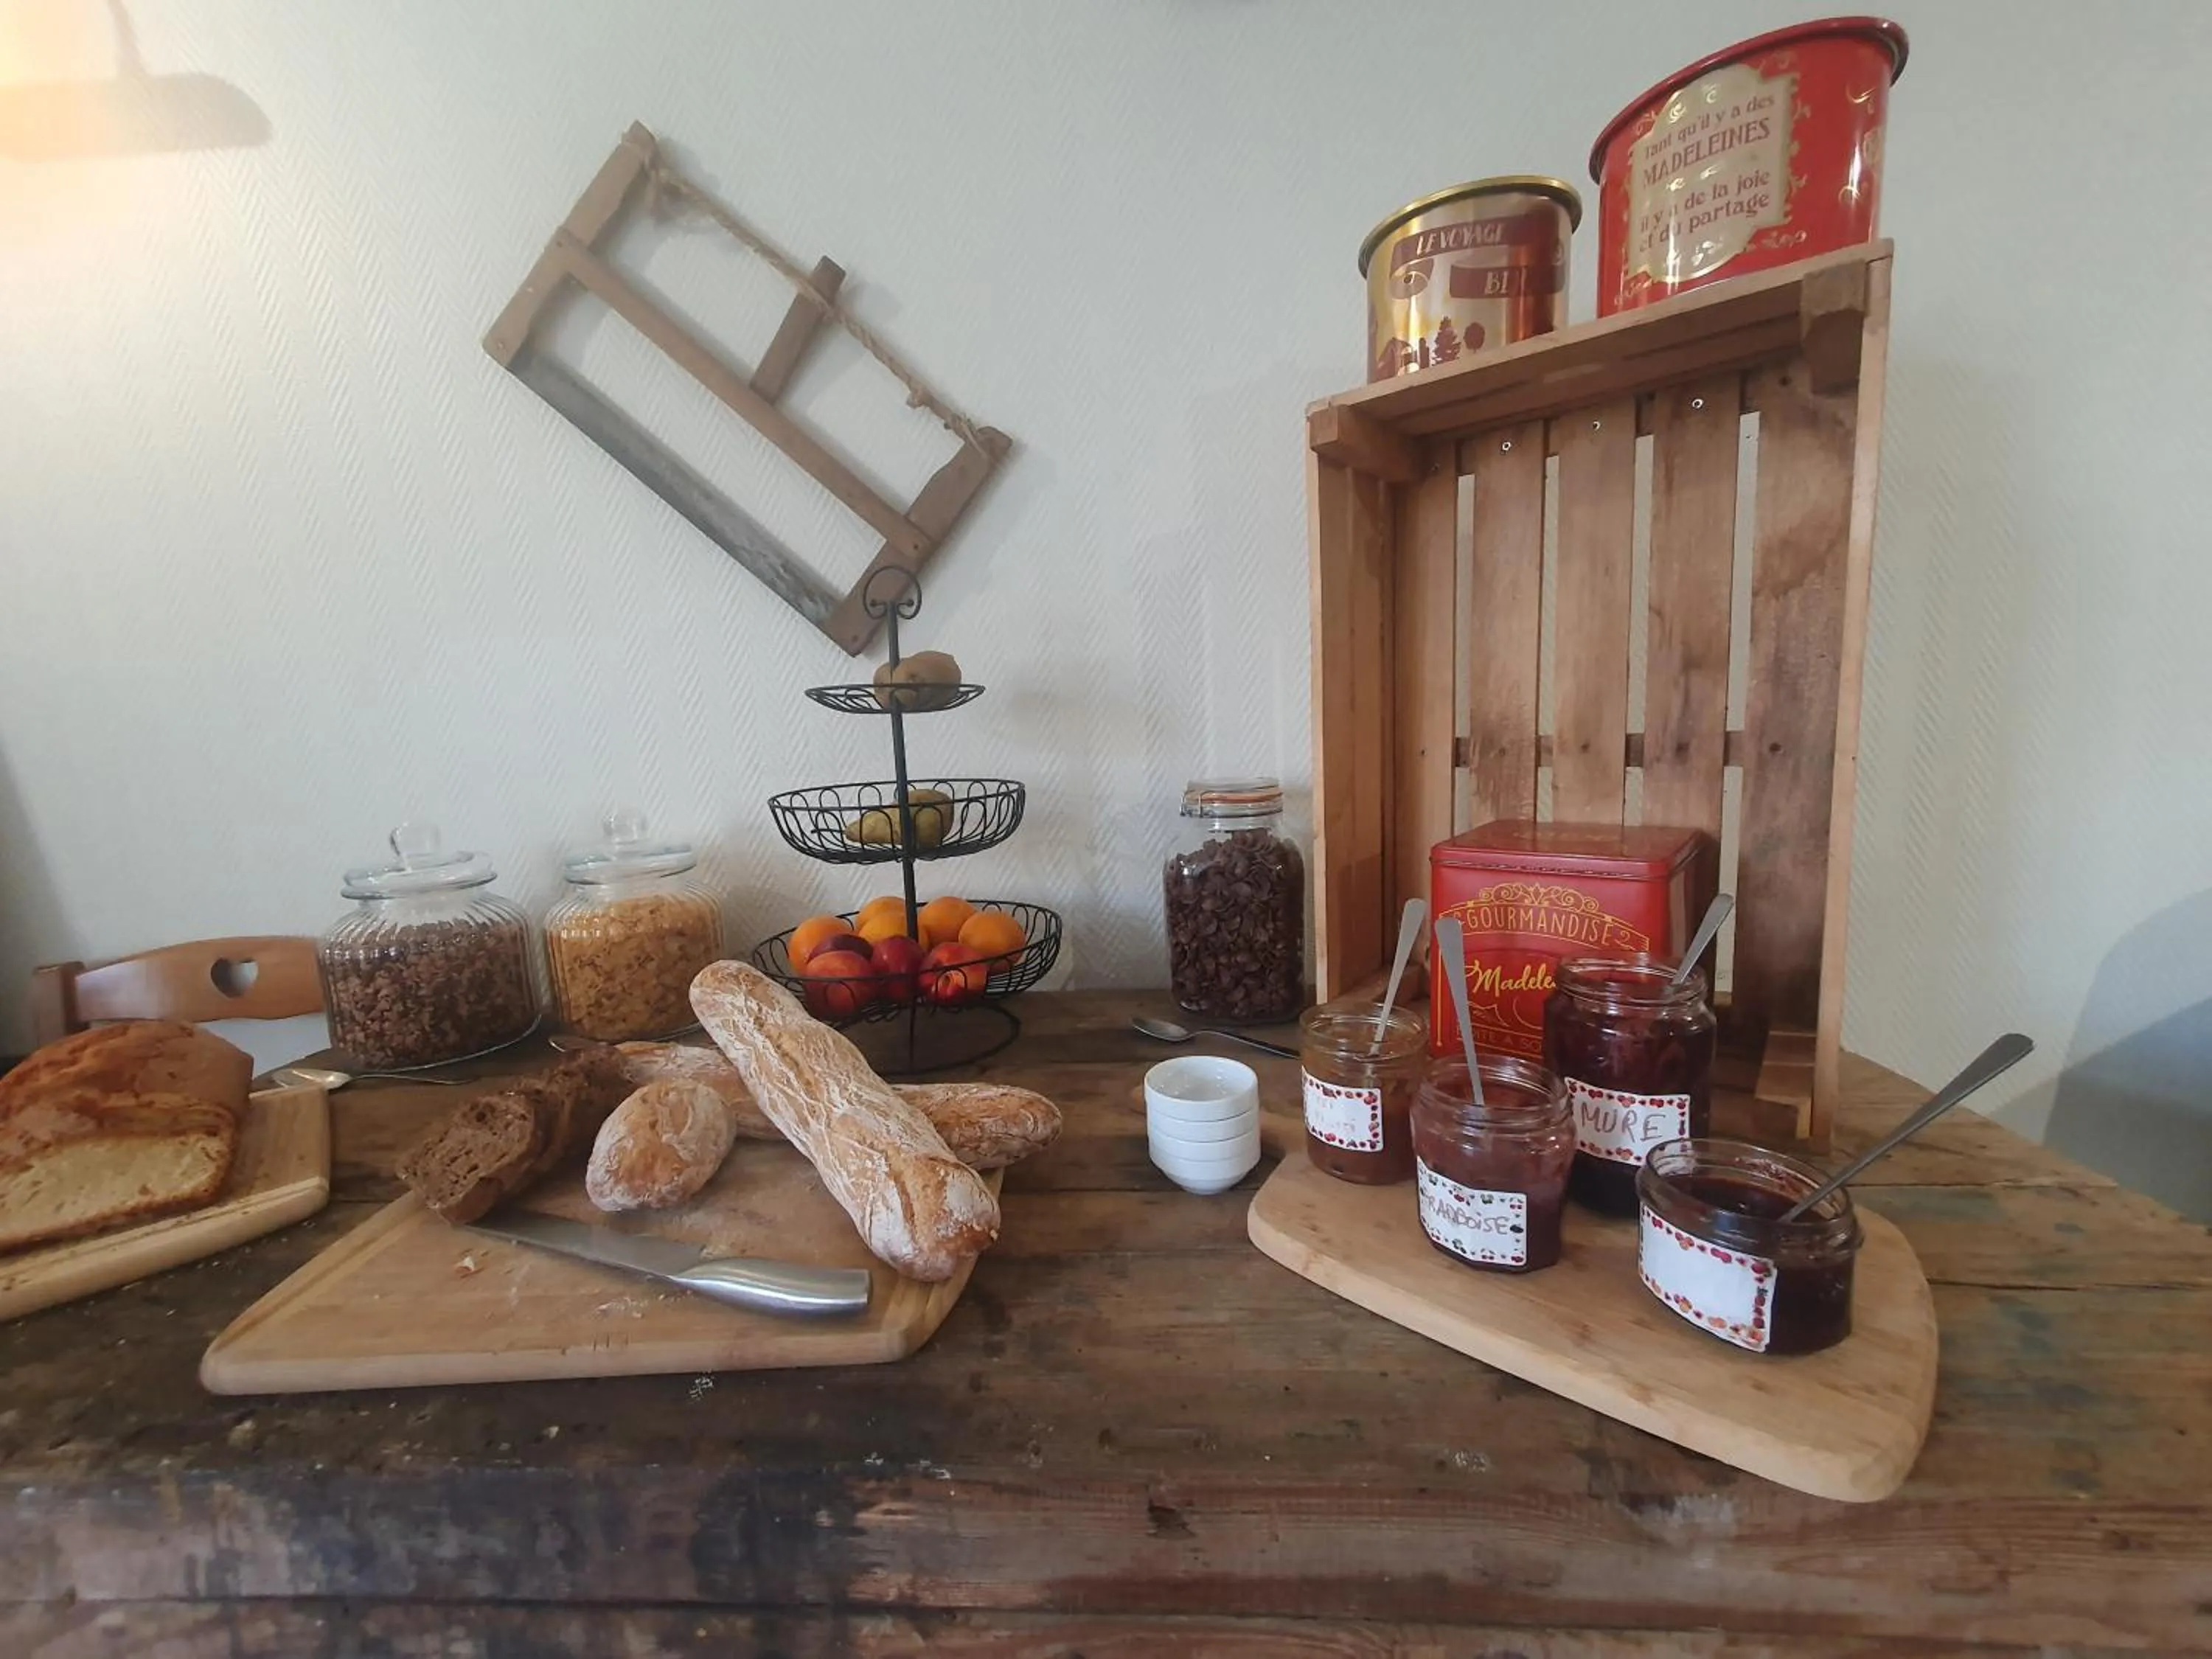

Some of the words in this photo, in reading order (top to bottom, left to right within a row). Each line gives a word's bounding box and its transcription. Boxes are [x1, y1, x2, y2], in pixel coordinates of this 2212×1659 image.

[1715, 111, 1726, 125] y
[1730, 105, 1741, 119] a
[1746, 94, 1775, 113] des
[1644, 116, 1770, 188] MADELEINES
[1654, 209, 1664, 230] y
[1684, 192, 1706, 210] de
[1712, 182, 1729, 201] la
[1736, 169, 1771, 196] joie
[1688, 193, 1770, 234] partage
[1467, 905, 1615, 947] GOURMANDISE
[1465, 959, 1557, 998] Madele
